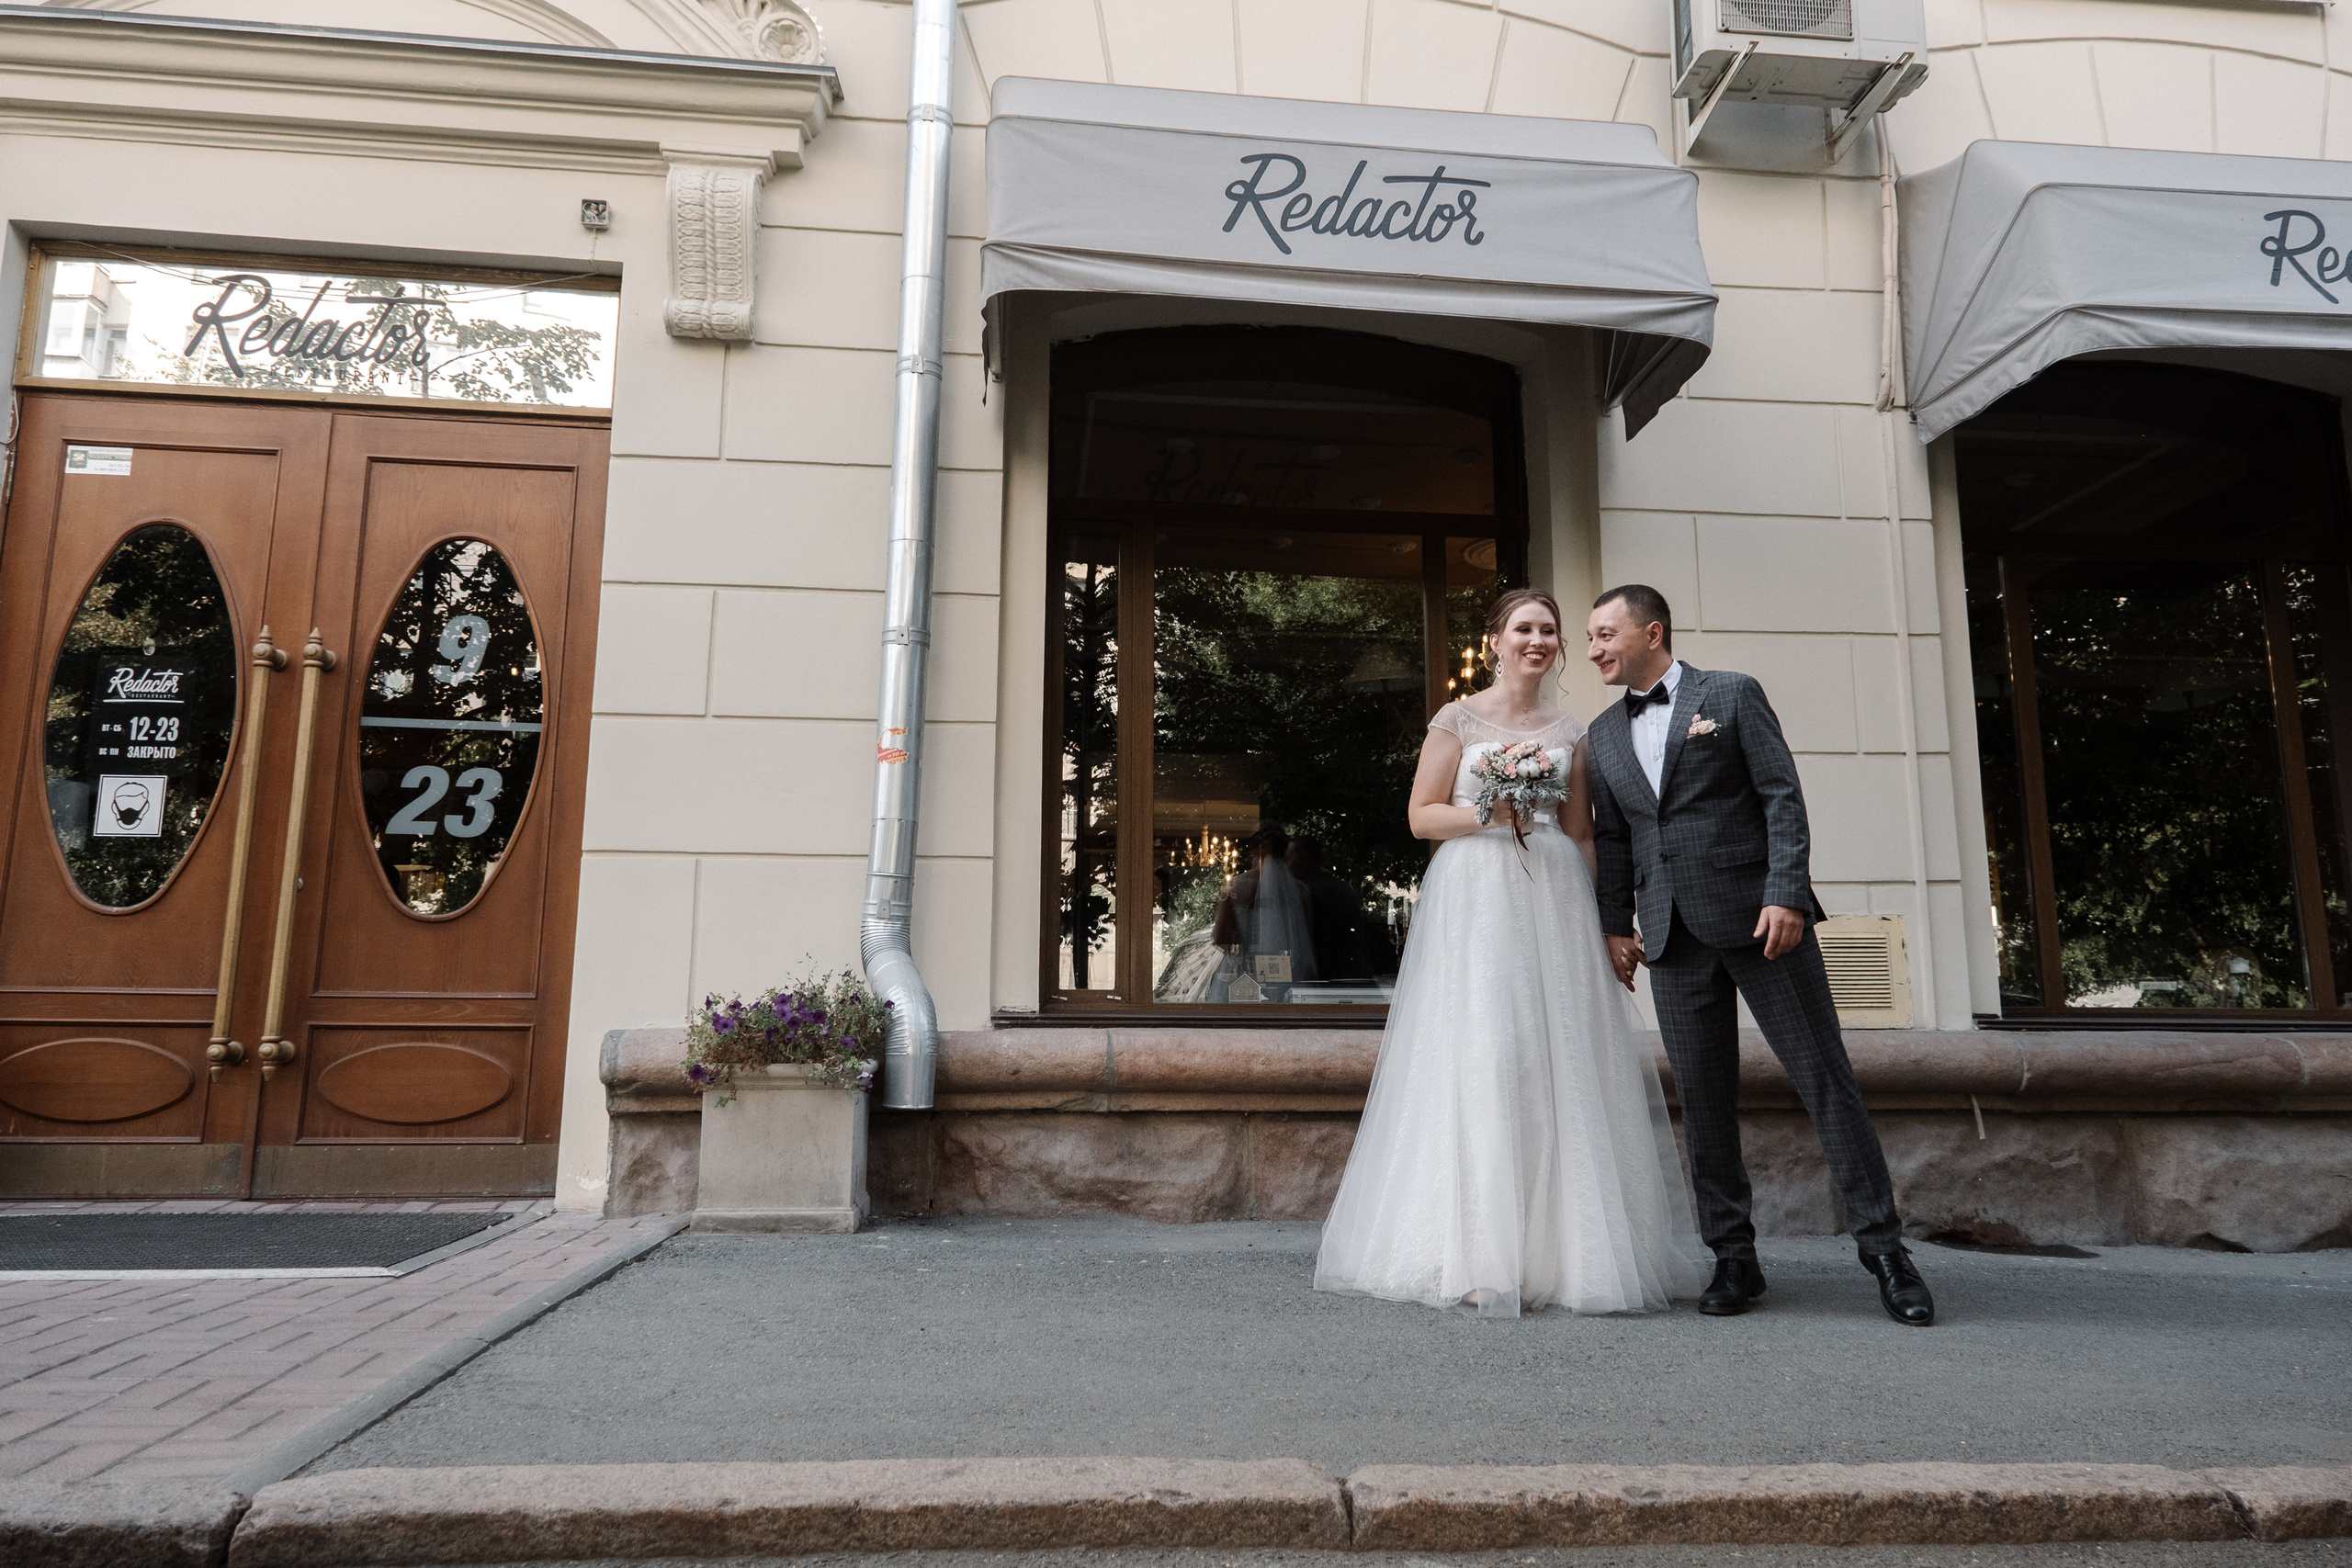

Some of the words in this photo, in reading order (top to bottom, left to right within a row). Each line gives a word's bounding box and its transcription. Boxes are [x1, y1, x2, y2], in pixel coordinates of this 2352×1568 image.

[1222, 152, 1491, 255] Redactor
[2260, 209, 2352, 305] Re
[184, 274, 445, 378] Redactor
[269, 365, 403, 385] RESTAURANT
[107, 667, 185, 699] Redactor
[432, 615, 491, 684] 9
[127, 746, 177, 759] ЗАКРЫТО
[130, 716, 180, 741] 12-23
[385, 764, 503, 839] 23
